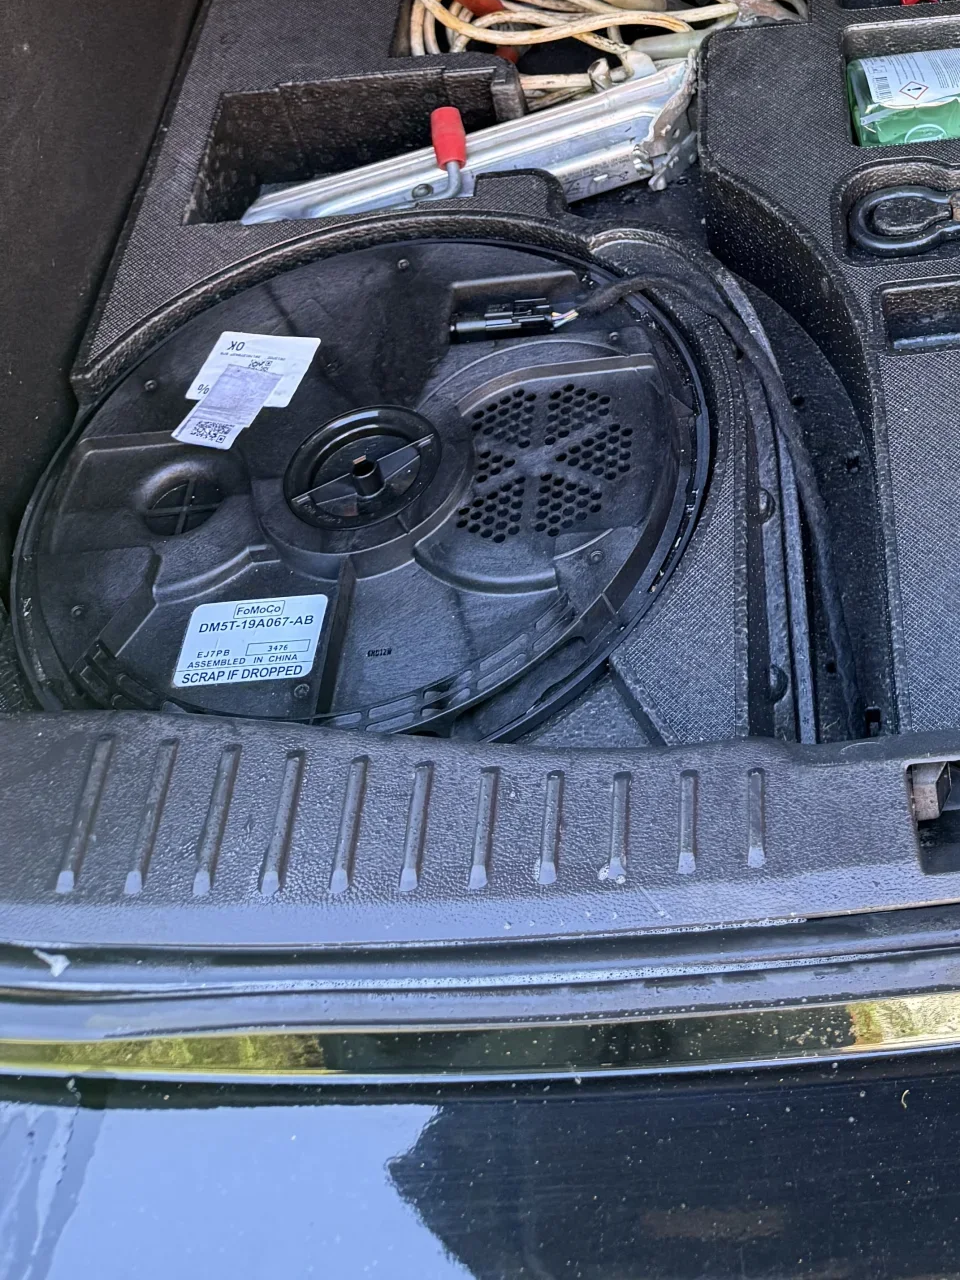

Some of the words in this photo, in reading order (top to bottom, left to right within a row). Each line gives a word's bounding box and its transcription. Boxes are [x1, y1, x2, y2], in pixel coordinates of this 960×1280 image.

[227, 341, 245, 351] OK
[236, 604, 281, 616] FoMoCo
[199, 615, 314, 633] DM5T-19A067-AB
[196, 649, 231, 659] EJ7PB
[267, 644, 289, 652] 3476
[187, 657, 246, 669] ASSEMBLED
[268, 654, 298, 663] CHINA
[181, 671, 225, 684] SCRAP
[227, 669, 239, 681] IF
[241, 665, 303, 679] DROPPED
